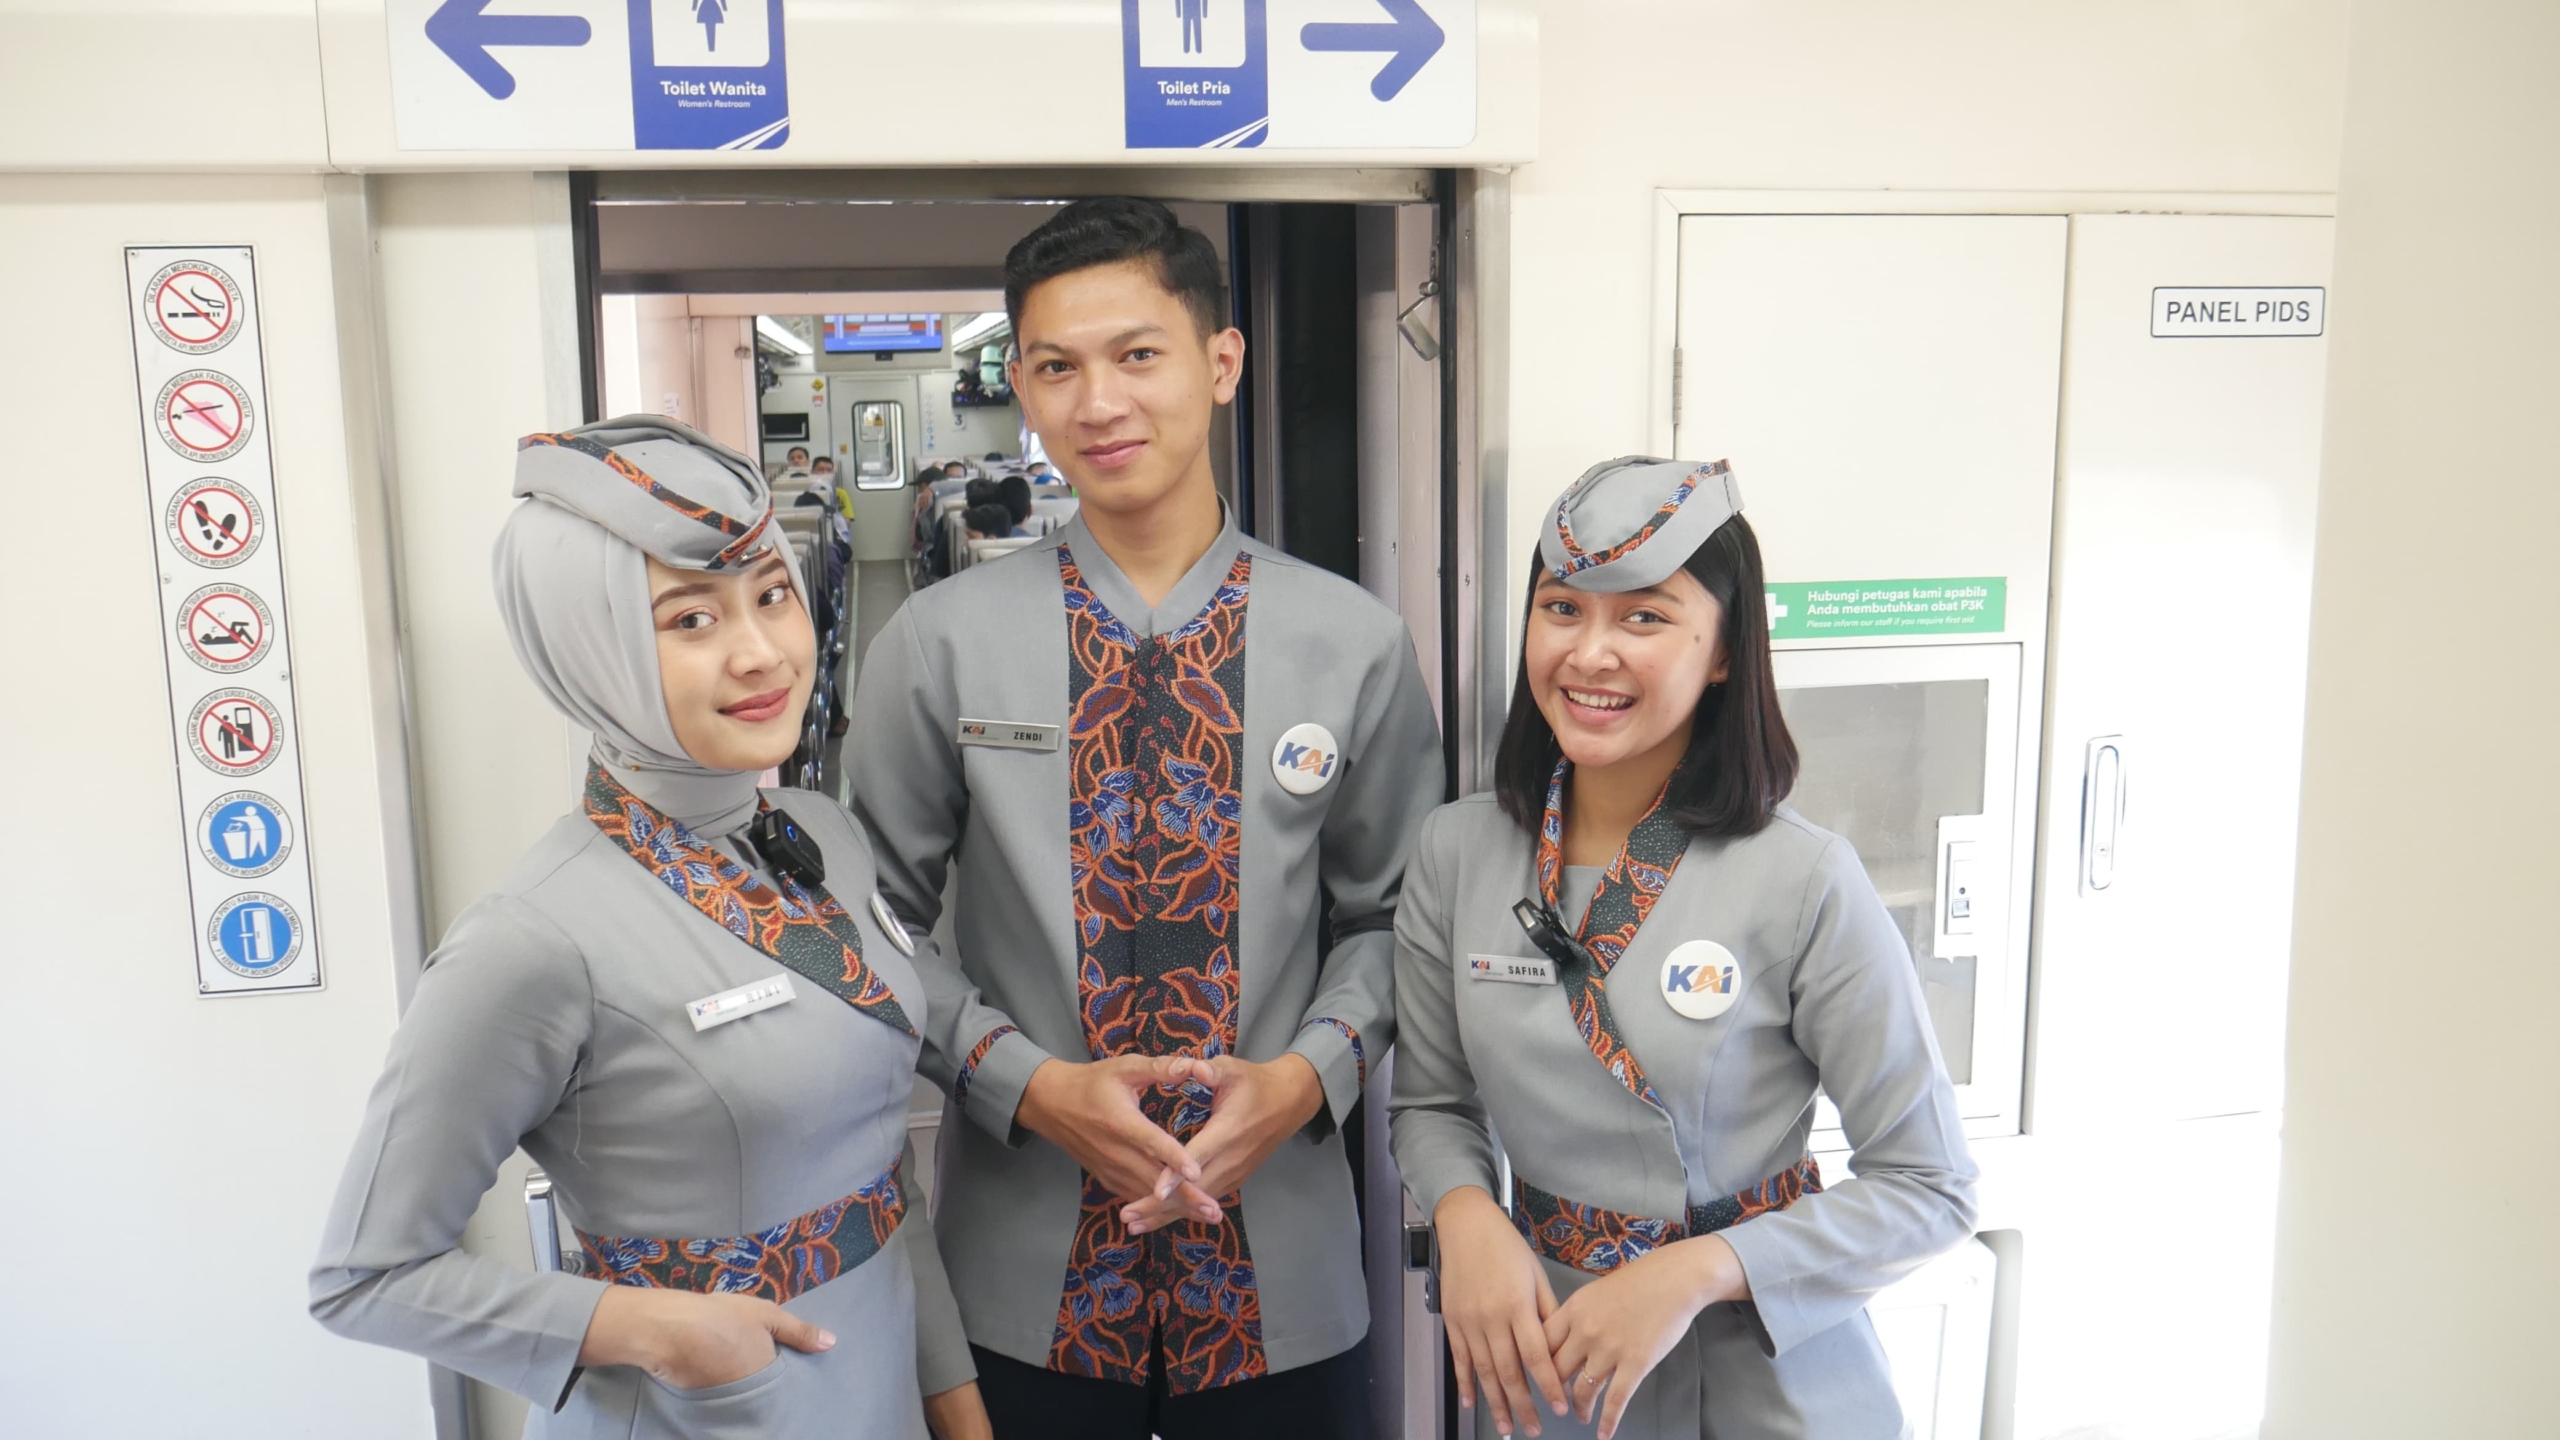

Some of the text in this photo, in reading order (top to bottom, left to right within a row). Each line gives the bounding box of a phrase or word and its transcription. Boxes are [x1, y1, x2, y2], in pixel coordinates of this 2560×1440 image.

[660, 81, 766, 95] Toilet Wanita
[1157, 81, 1231, 94] Toilet Pria
[678, 99, 751, 108] Women's Restroom
[1166, 98, 1223, 106] Men's Restroom
[2166, 301, 2311, 322] PANEL PIDS
[954, 414, 964, 427] 3
[1807, 586, 1988, 603] Hubungi petugas kami apabila
[1807, 599, 1985, 615] Anda membutuhkan obat P3K
[1806, 620, 1832, 628] Please
[1834, 618, 1859, 628] inform
[1875, 617, 1894, 627] staff
[1893, 617, 1901, 626] if
[1900, 618, 1915, 627] you
[1916, 616, 1943, 626] require
[1944, 615, 1961, 625] first
[1961, 615, 1975, 624] aid
[1013, 731, 1043, 742] ZENDI
[205, 793, 283, 819] JAGALAH KEBERSIHAN
[1508, 965, 1546, 977] SAFIRA
